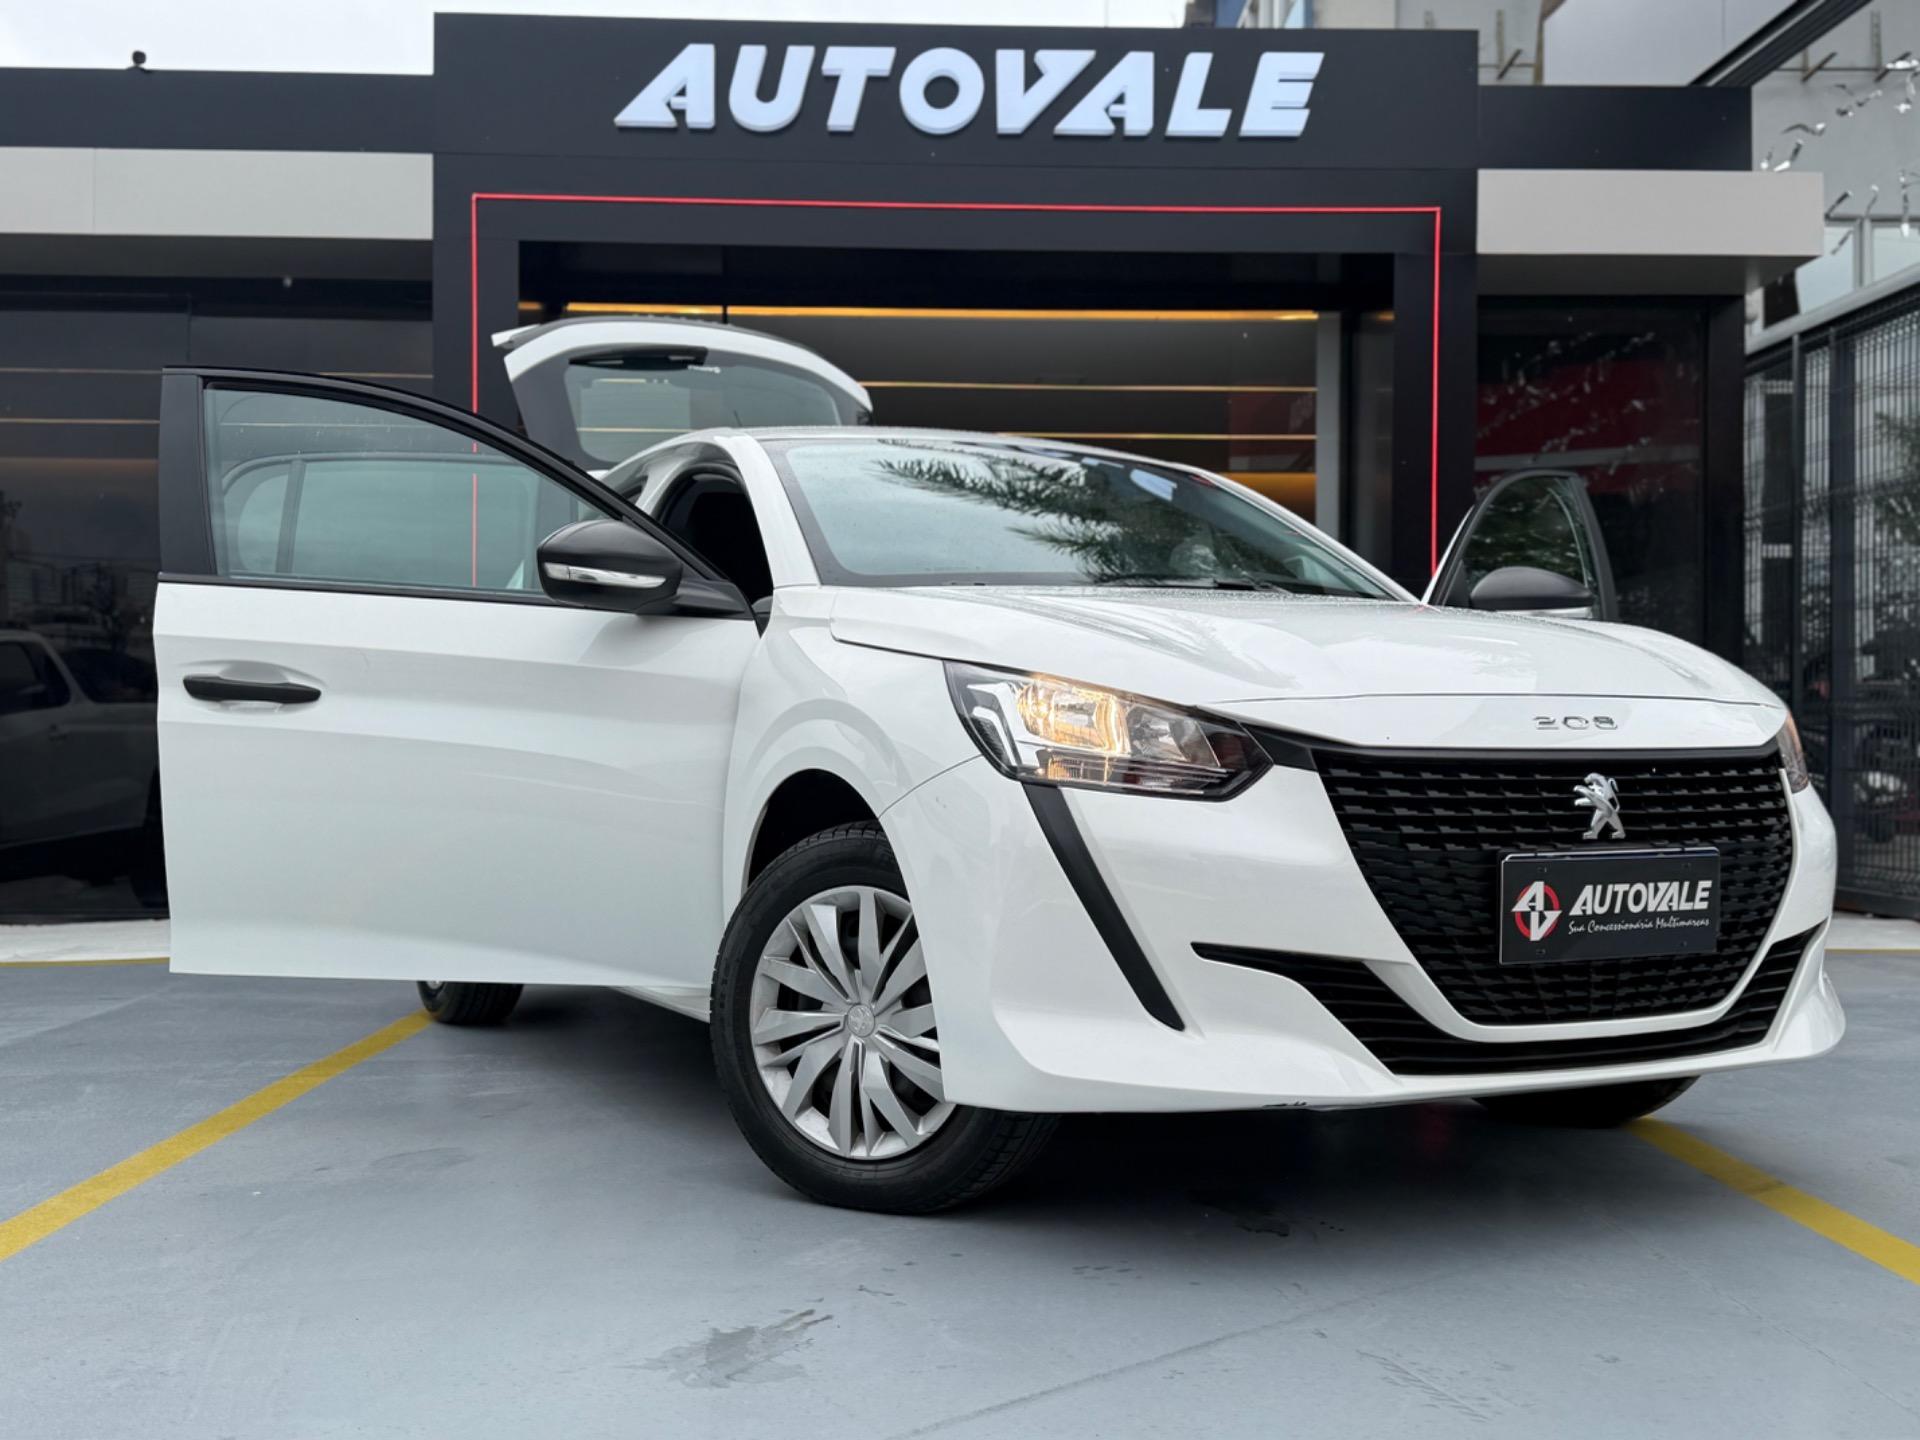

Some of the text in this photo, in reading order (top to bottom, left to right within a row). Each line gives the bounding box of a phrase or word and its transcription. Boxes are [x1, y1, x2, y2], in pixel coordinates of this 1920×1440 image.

[614, 43, 1325, 136] AUTOVALE
[1533, 715, 1618, 731] 208
[1568, 880, 1713, 916] AUTOVALE
[1568, 915, 1710, 935] Sua Concessionária Multimarcas
